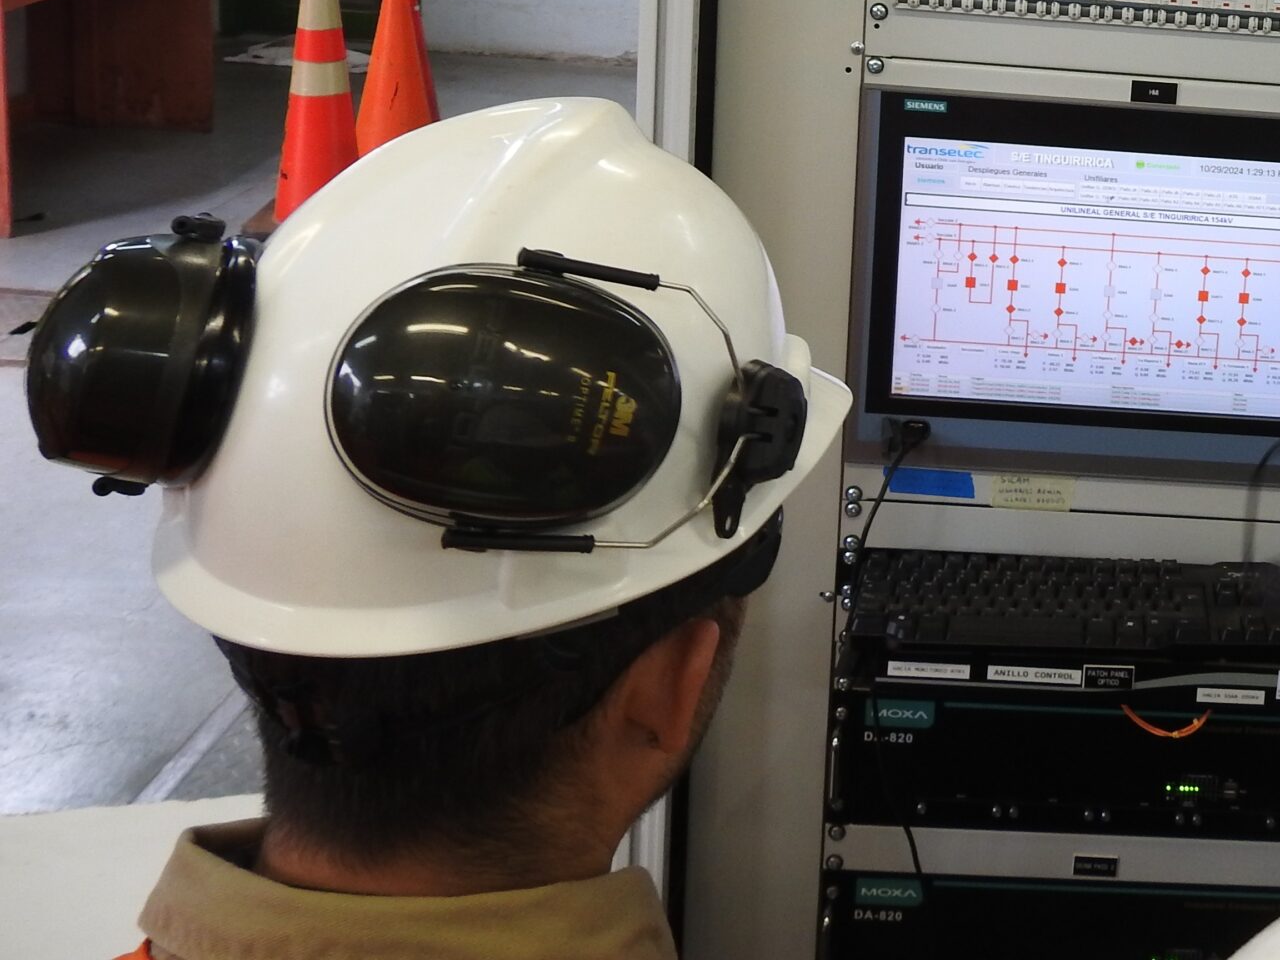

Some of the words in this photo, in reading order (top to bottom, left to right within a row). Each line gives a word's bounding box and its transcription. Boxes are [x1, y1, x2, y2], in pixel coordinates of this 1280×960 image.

[906, 101, 945, 111] SIEMENS
[906, 144, 986, 159] transelec
[1034, 152, 1115, 169] TINGUIRIRICA
[915, 162, 944, 172] Usuario
[1200, 165, 1244, 176] 10/29/2024
[1246, 168, 1276, 178] 1:29:13
[1012, 169, 1048, 178] Generales
[1060, 206, 1101, 215] UNILINEAL
[1103, 208, 1140, 218] GENERAL
[1142, 212, 1156, 220] S/E
[1158, 212, 1210, 223] TINGUIRIRICA
[1212, 216, 1234, 224] 154kV
[993, 669, 1029, 678] ANILLO
[1034, 672, 1075, 681] CONTROL
[1087, 670, 1108, 678] PATCH
[1110, 670, 1130, 678] PANEL
[860, 886, 918, 898] MOXA
[854, 909, 903, 921] DA-820
